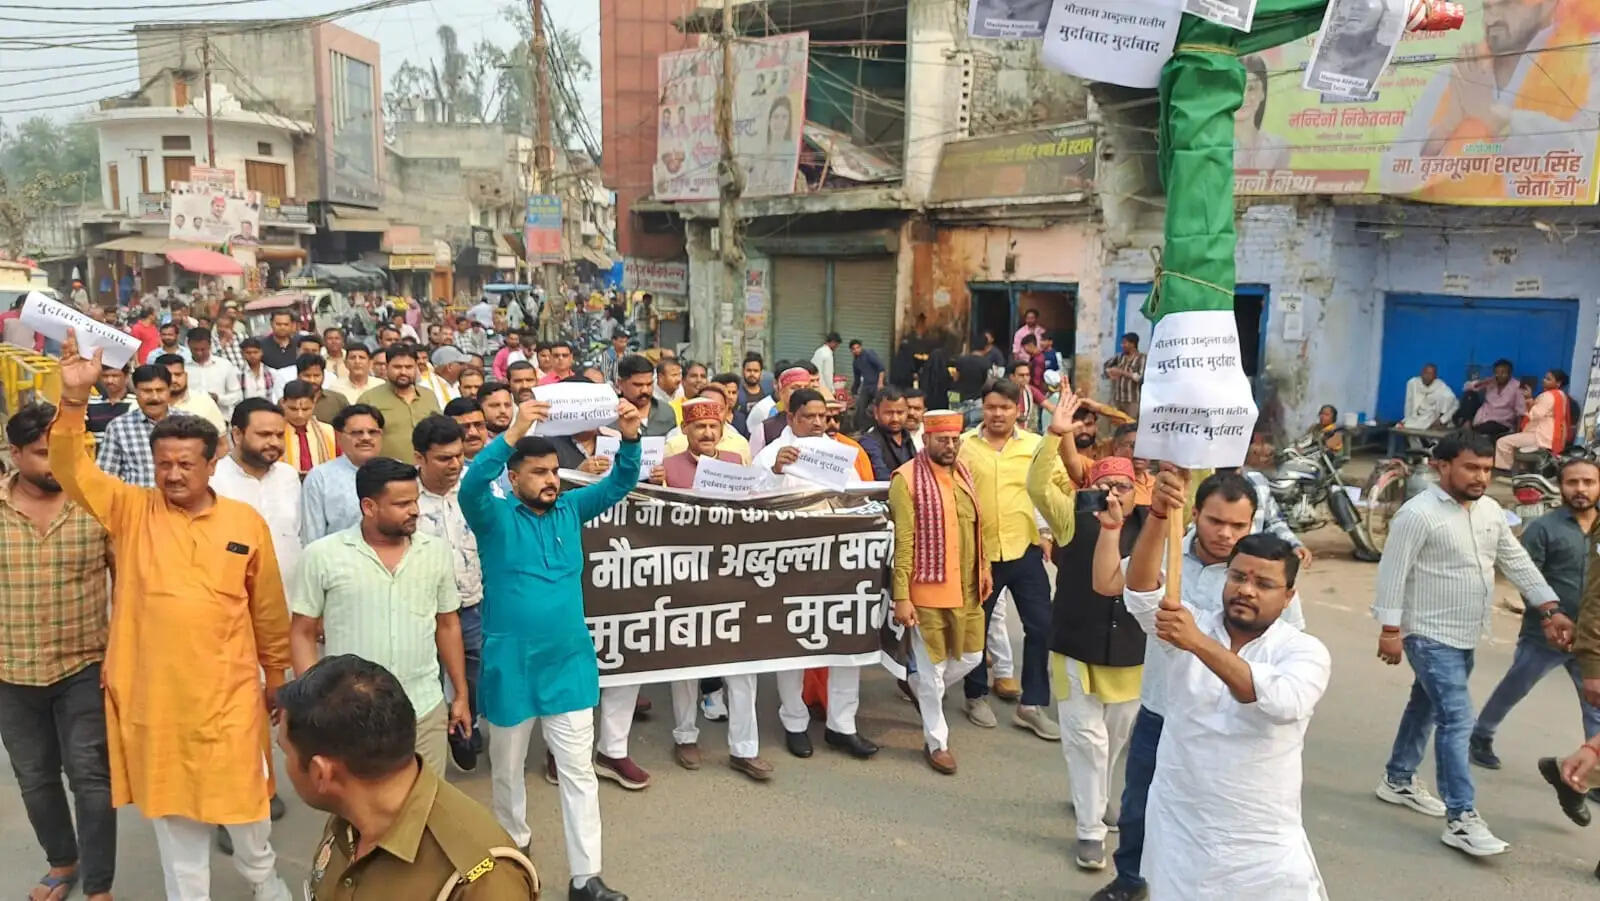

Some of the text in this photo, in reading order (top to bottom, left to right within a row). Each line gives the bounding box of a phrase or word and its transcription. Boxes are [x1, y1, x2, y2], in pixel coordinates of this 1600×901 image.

[1059, 24, 1161, 53] मुर्दाबाद मुर्दाबाद
[1494, 155, 1541, 174] शरण
[1157, 354, 1204, 375] मुर्दाबाद
[589, 536, 714, 590] मौलाना
[718, 535, 836, 588] अब्दुल्ला
[584, 596, 746, 669] मुर्दाबाद
